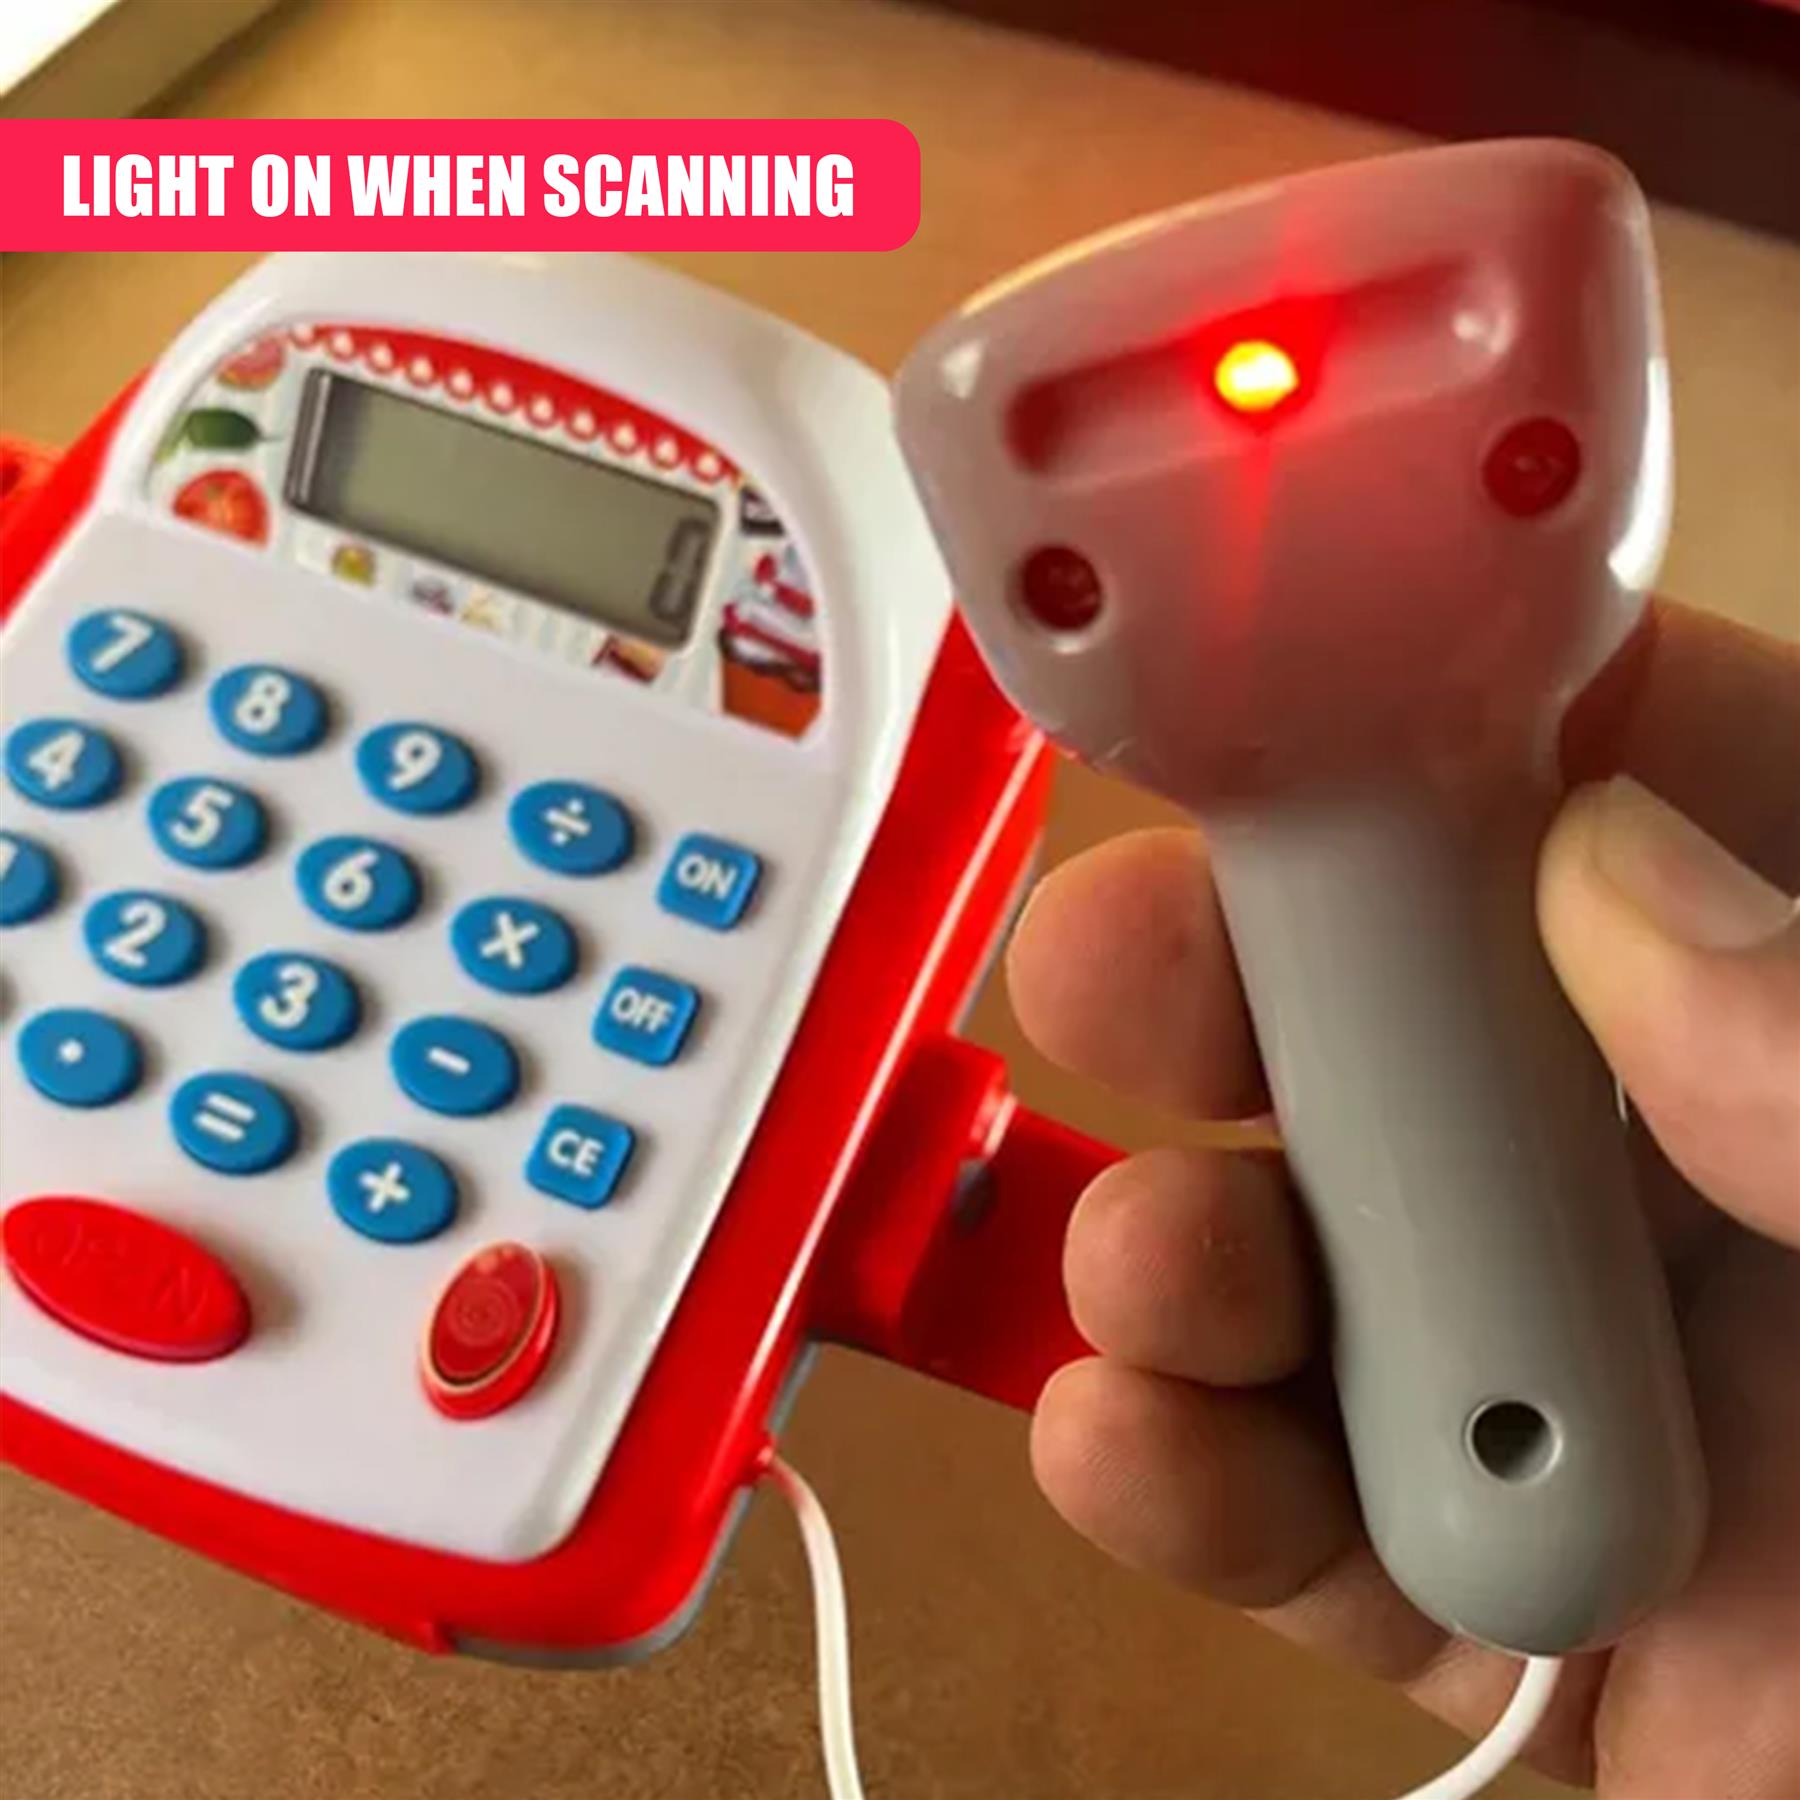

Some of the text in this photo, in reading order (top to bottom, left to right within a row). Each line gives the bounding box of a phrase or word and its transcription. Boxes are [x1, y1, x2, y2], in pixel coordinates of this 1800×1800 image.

[92, 614, 153, 672] 7
[233, 672, 290, 735] 8
[28, 730, 86, 791] 4
[390, 732, 442, 789] 9
[171, 785, 232, 848] 5
[323, 849, 378, 910] 6
[677, 852, 737, 898] ON
[105, 900, 166, 967] 2
[260, 963, 318, 1029] 3
[612, 988, 672, 1034] OFF
[196, 1094, 256, 1142] =
[548, 1130, 602, 1176] CE
[361, 1163, 409, 1212] +
